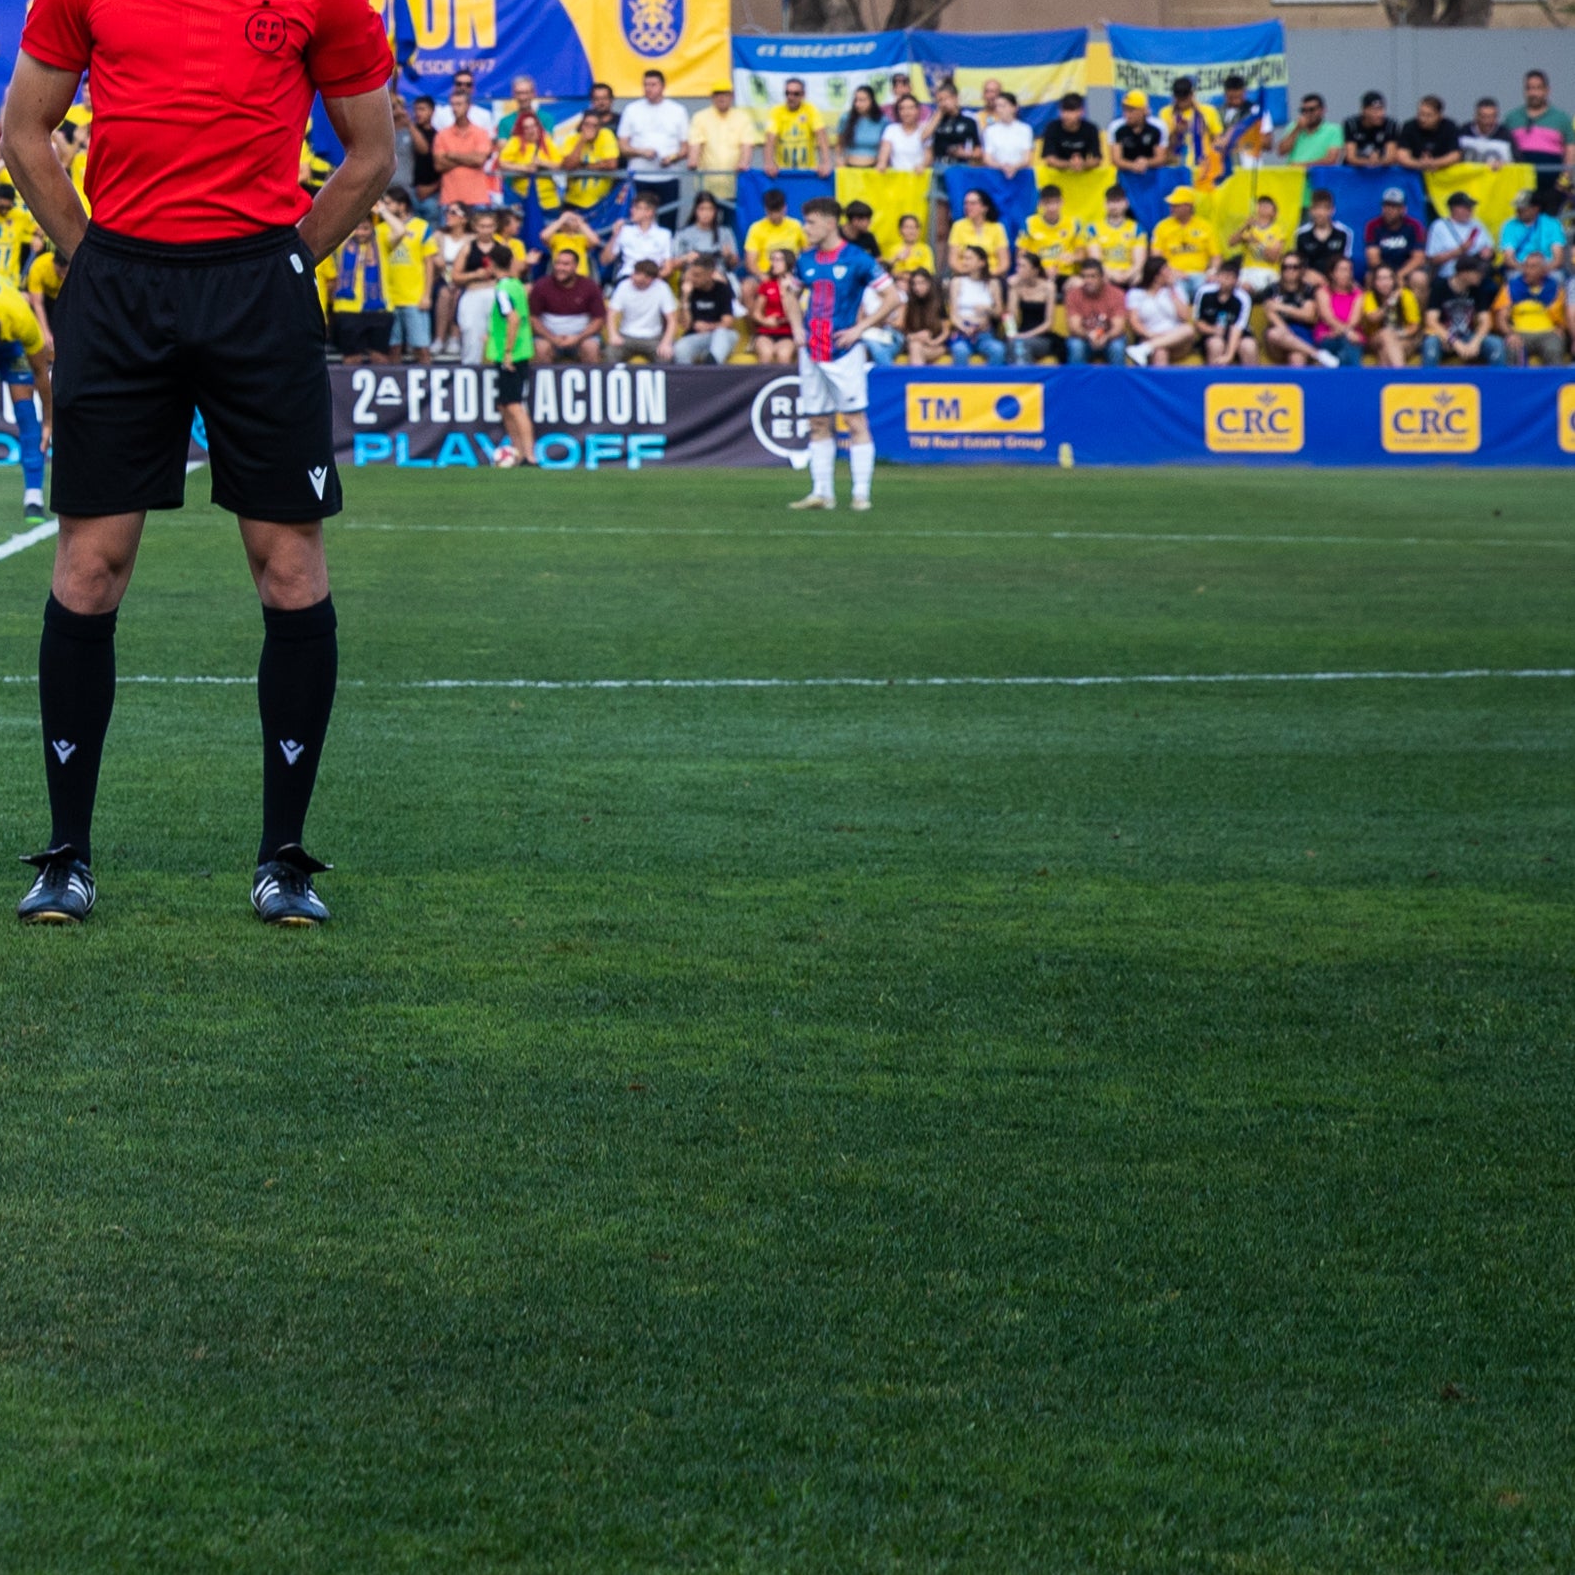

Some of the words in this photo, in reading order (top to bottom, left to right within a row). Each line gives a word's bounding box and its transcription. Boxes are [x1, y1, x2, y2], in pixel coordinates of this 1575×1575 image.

[407, 362, 667, 425] FEDEACIÓN
[918, 398, 961, 421] TM
[1216, 408, 1291, 434] CRC
[1392, 408, 1468, 434] CRC
